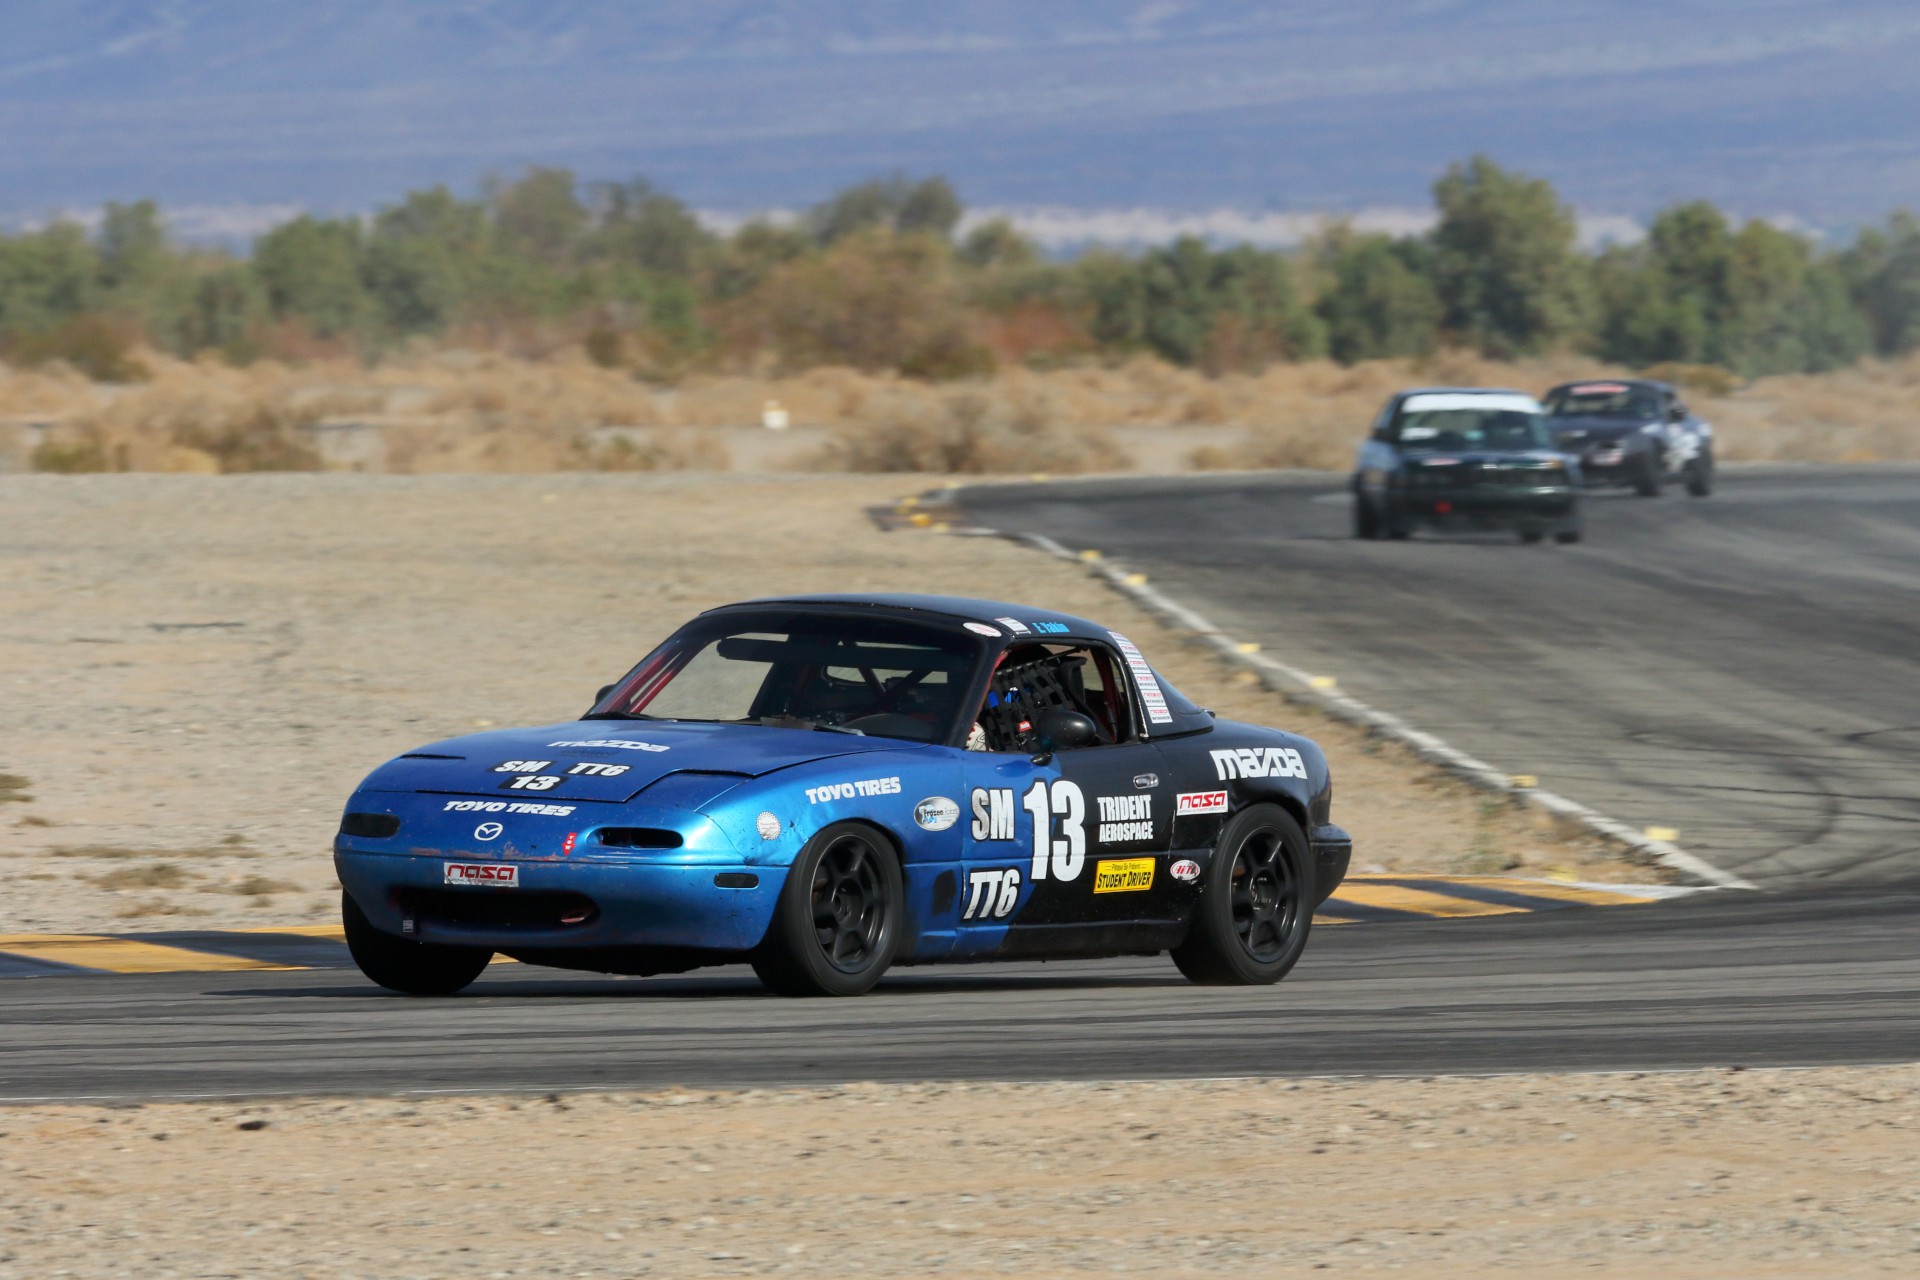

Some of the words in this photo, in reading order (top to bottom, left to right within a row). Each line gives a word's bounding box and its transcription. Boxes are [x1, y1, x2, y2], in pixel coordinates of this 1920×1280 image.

[494, 760, 552, 773] SM
[567, 762, 631, 777] TT6
[510, 775, 561, 790] 13
[805, 783, 856, 805] TOYO
[854, 776, 902, 797] TIRES
[443, 801, 507, 812] TOYO
[505, 803, 577, 817] TIRES
[971, 788, 1015, 840] SM
[1097, 794, 1152, 822] TRIDENT
[1023, 780, 1086, 882] 13
[1098, 821, 1154, 843] AEROSPACE
[1097, 872, 1127, 888] STUDENT
[1126, 871, 1152, 887] DRIVER
[963, 868, 1020, 920] TT6
